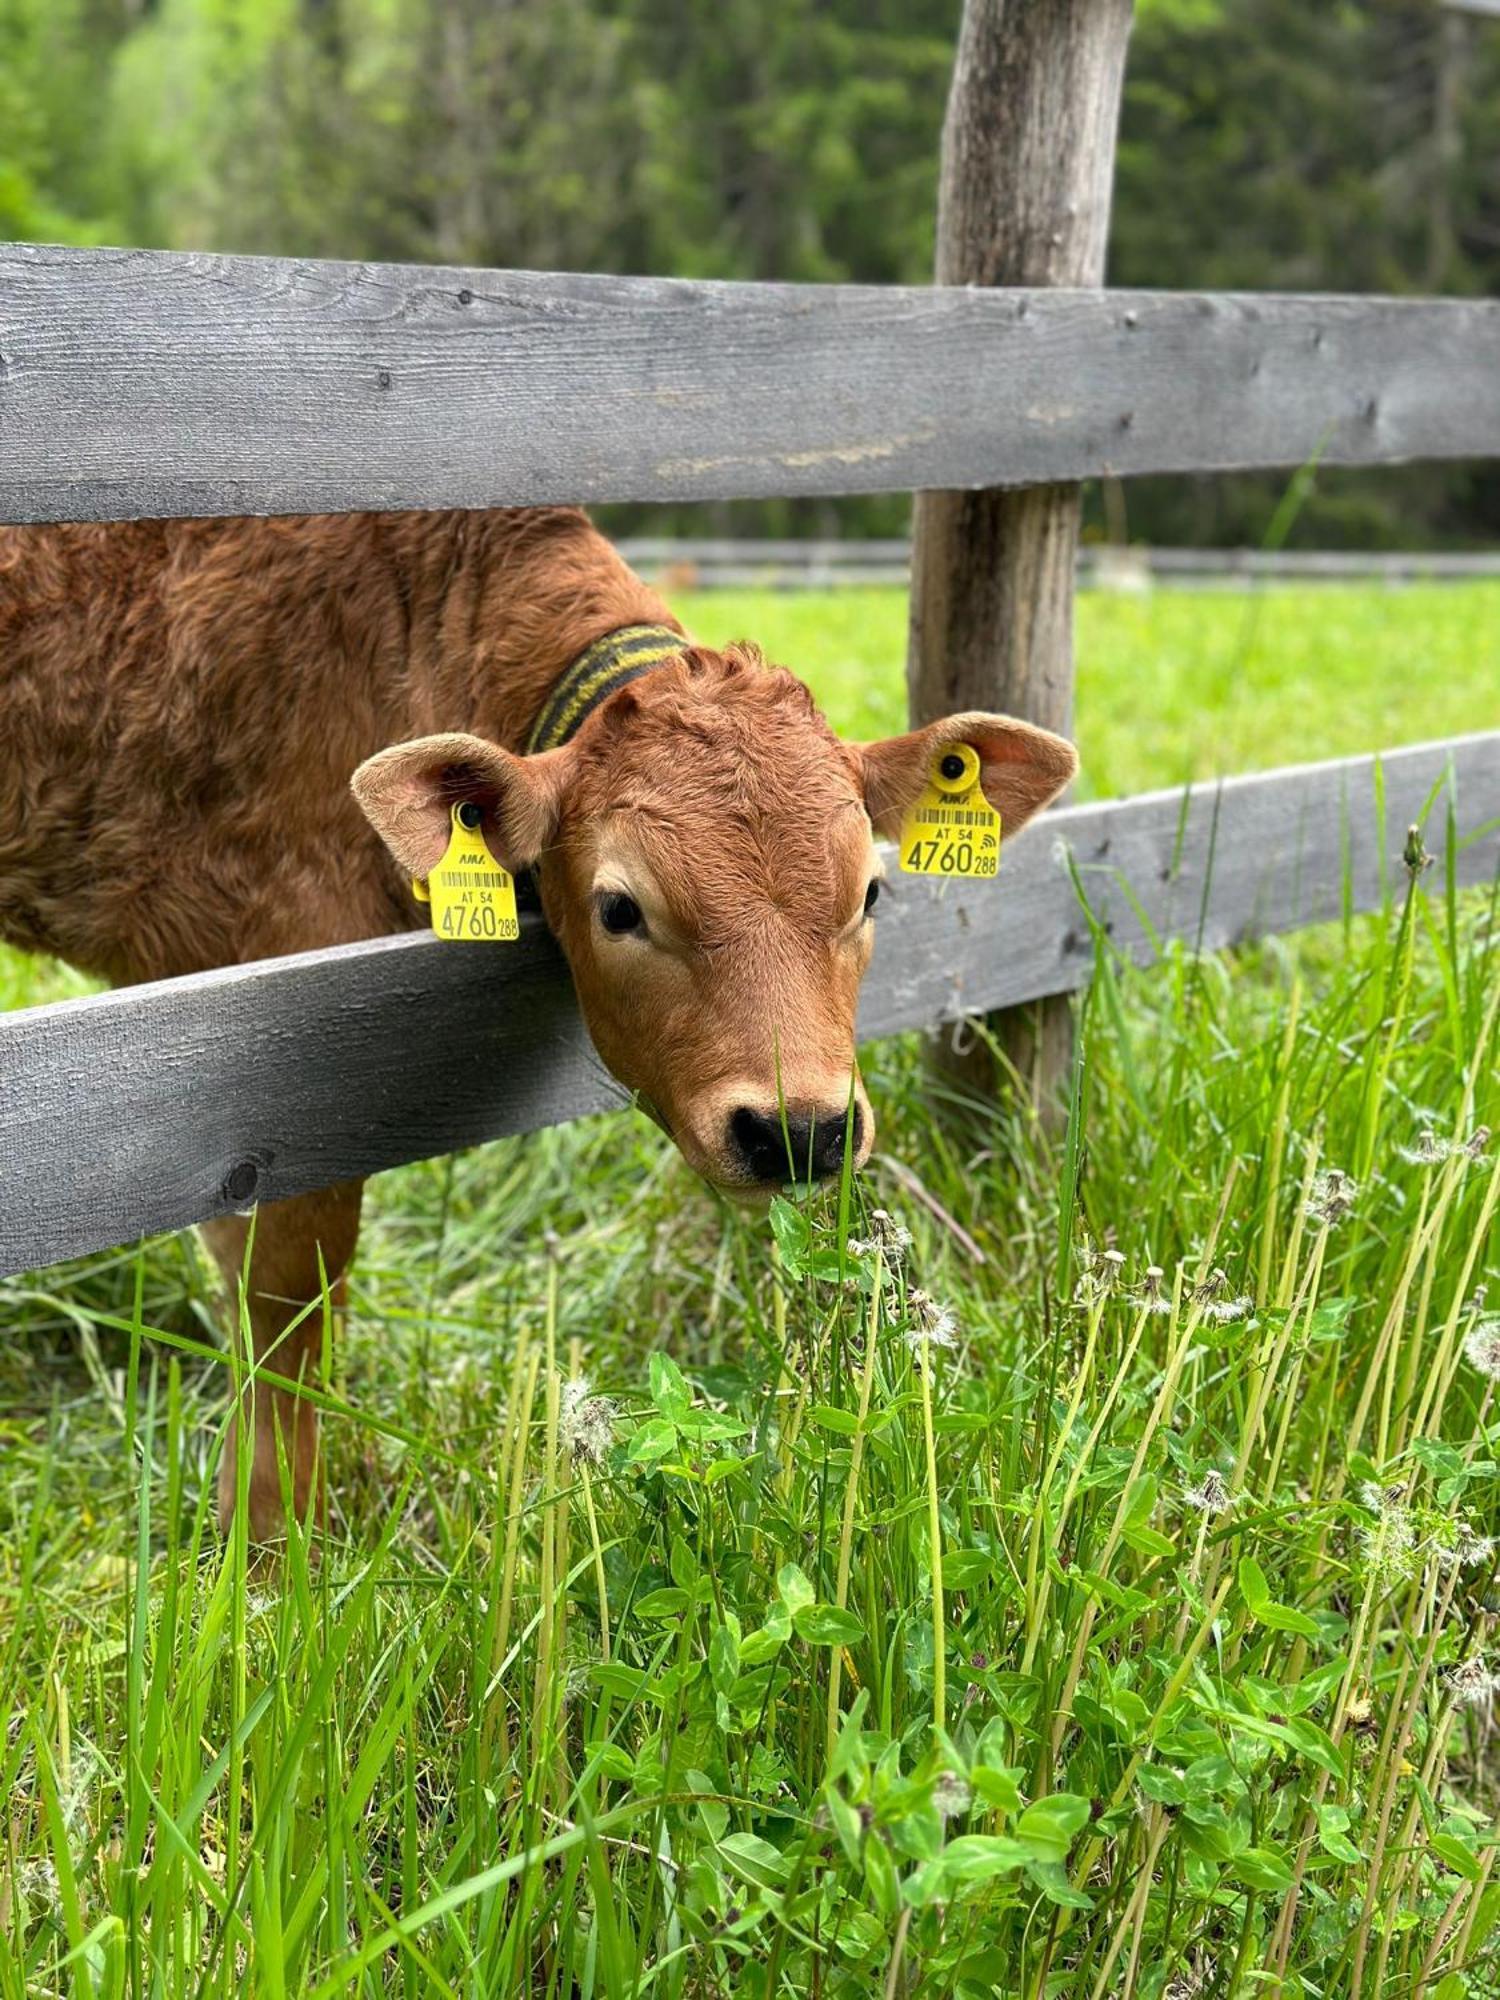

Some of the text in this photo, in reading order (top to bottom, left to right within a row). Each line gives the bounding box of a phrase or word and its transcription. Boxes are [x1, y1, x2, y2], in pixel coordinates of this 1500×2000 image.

[935, 829, 973, 841] AT 54
[907, 841, 996, 874] 4760 288
[462, 891, 493, 904] AT 54
[442, 906, 518, 937] 4760 288
